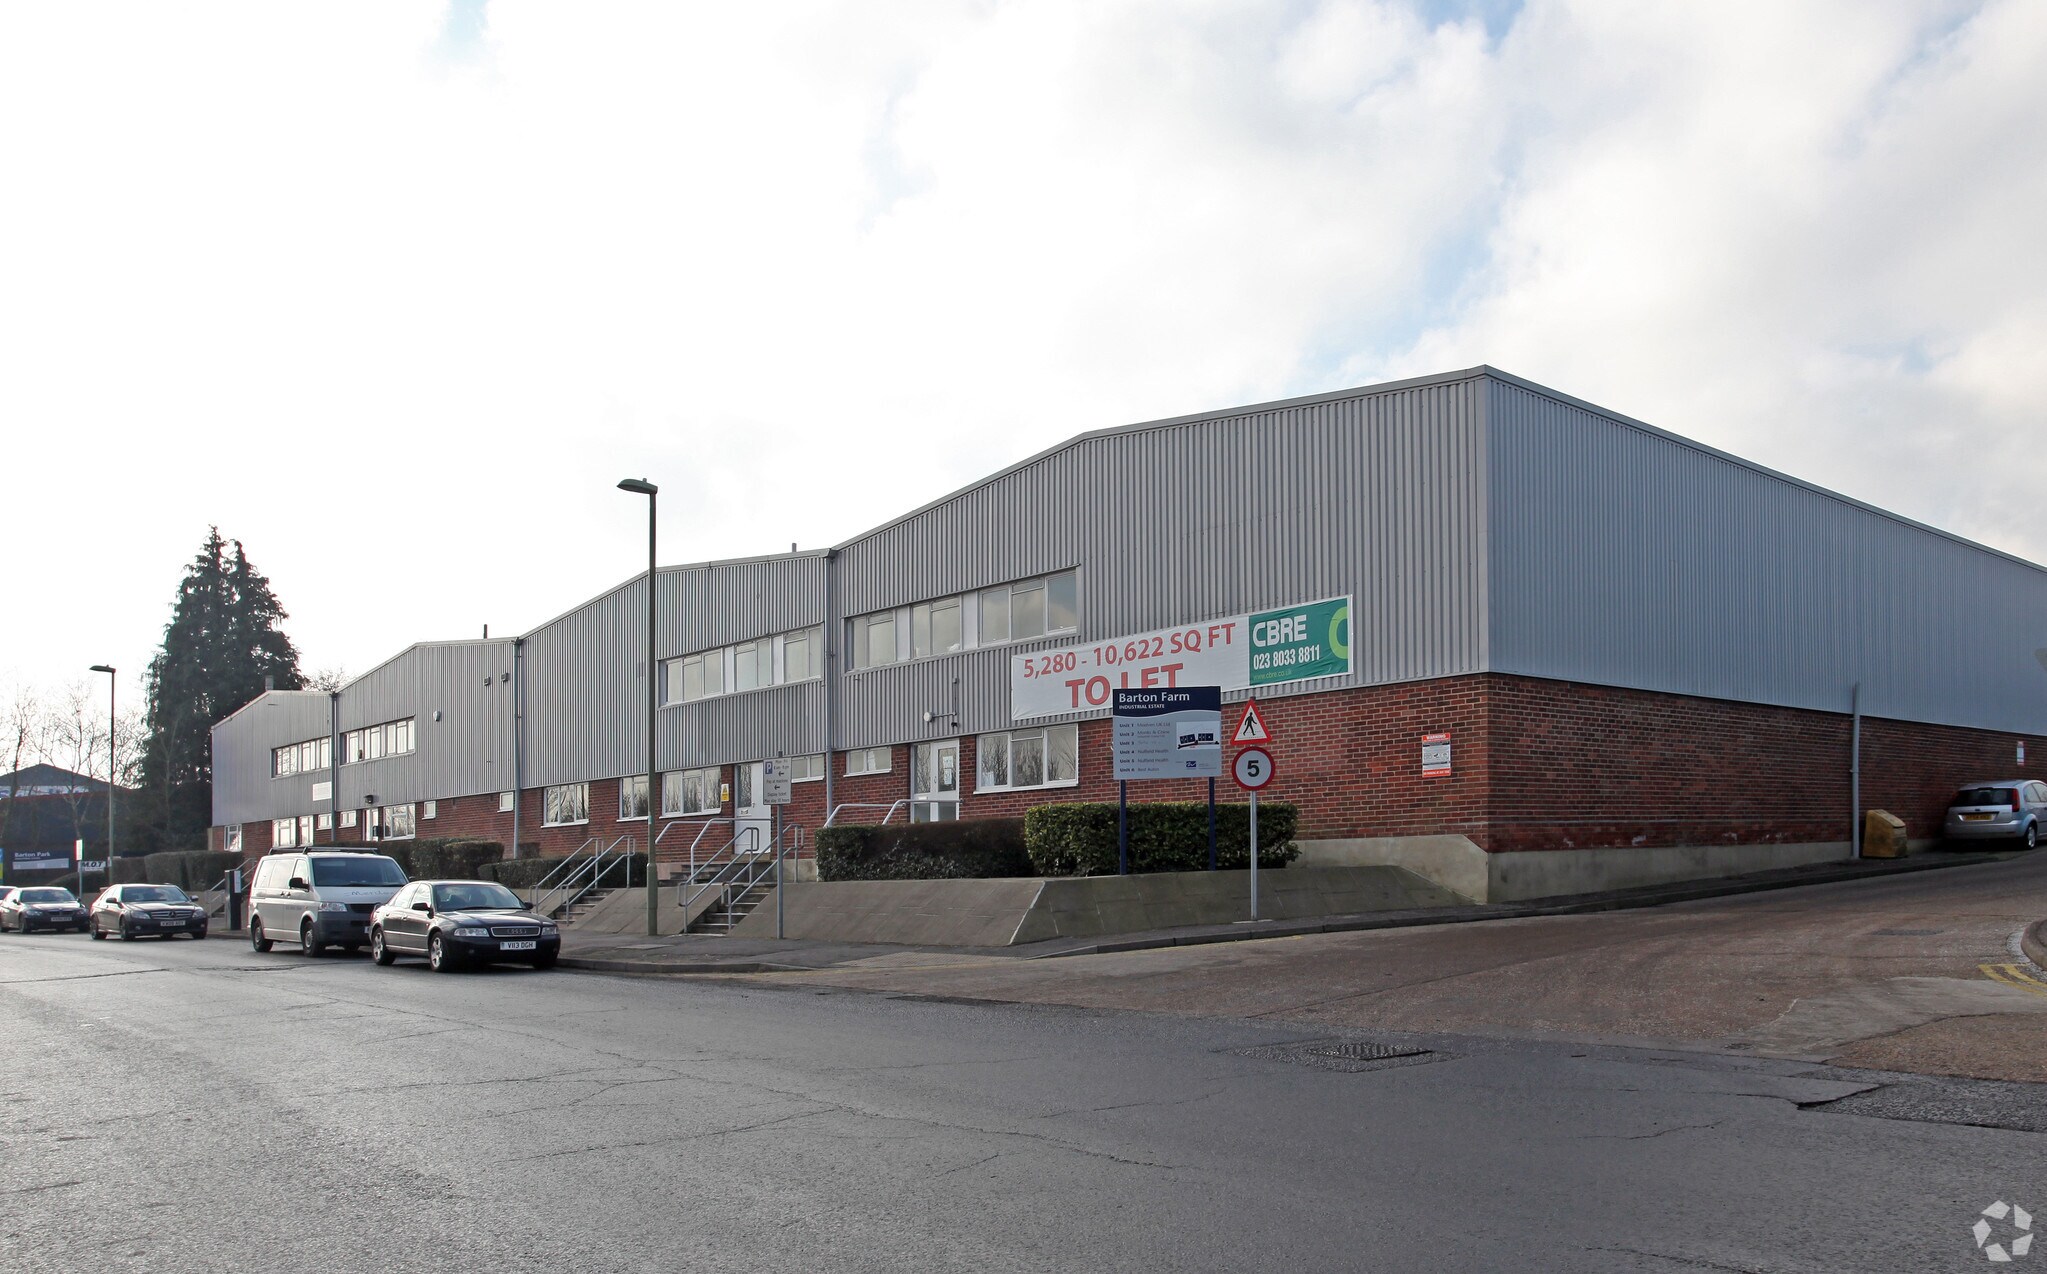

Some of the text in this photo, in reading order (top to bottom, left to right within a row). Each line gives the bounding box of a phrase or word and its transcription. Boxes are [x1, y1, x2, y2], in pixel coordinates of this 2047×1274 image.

[1253, 614, 1307, 647] CBRE
[1024, 652, 1076, 679] 5,280
[1093, 637, 1163, 666] 10,622
[1170, 630, 1201, 654] SQ
[1208, 623, 1236, 648] FT
[1253, 644, 1320, 670] 023 8033 8811
[1065, 675, 1111, 708] TO
[1119, 691, 1190, 703] Barton Farm
[766, 762, 772, 774] P
[1247, 760, 1260, 777] 5
